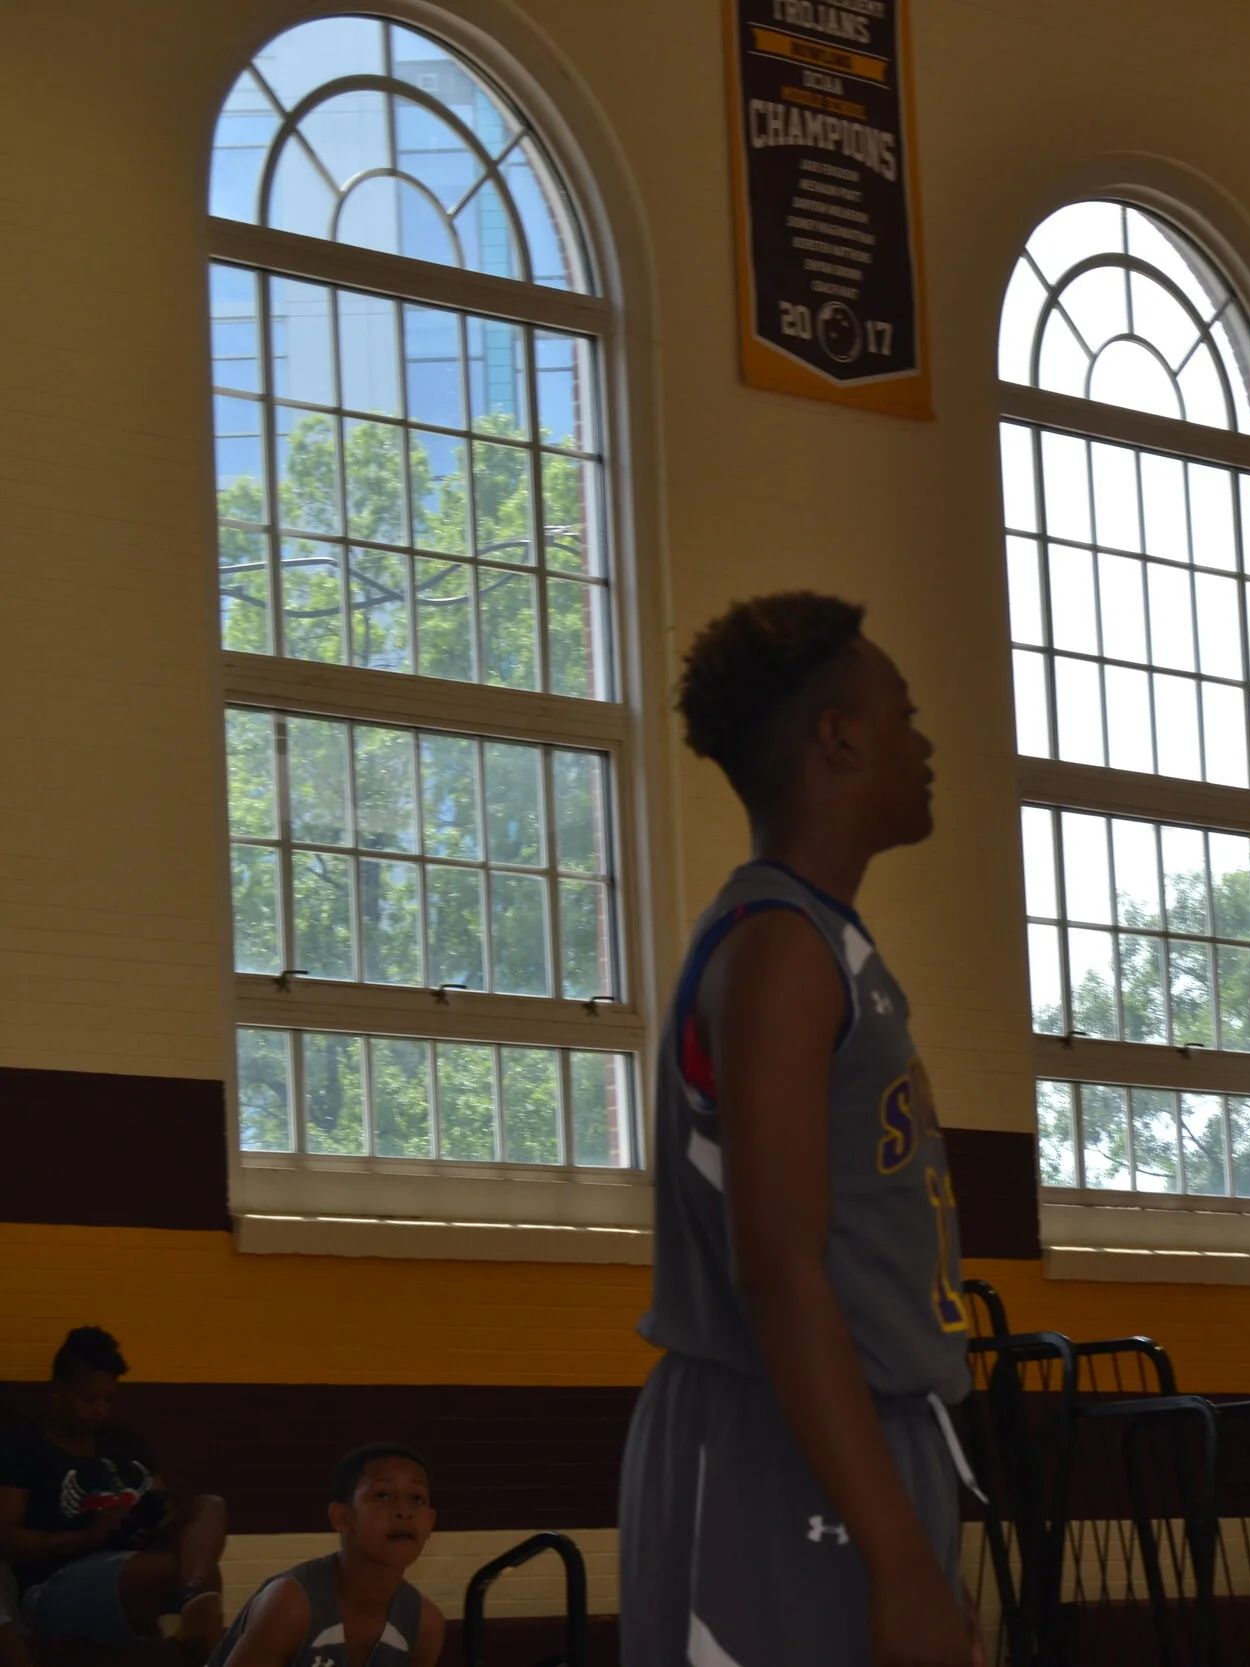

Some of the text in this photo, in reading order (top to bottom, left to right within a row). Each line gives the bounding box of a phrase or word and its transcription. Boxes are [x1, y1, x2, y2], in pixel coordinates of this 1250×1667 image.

[750, 99, 897, 182] CHAMPIONS
[778, 300, 894, 356] 20 17
